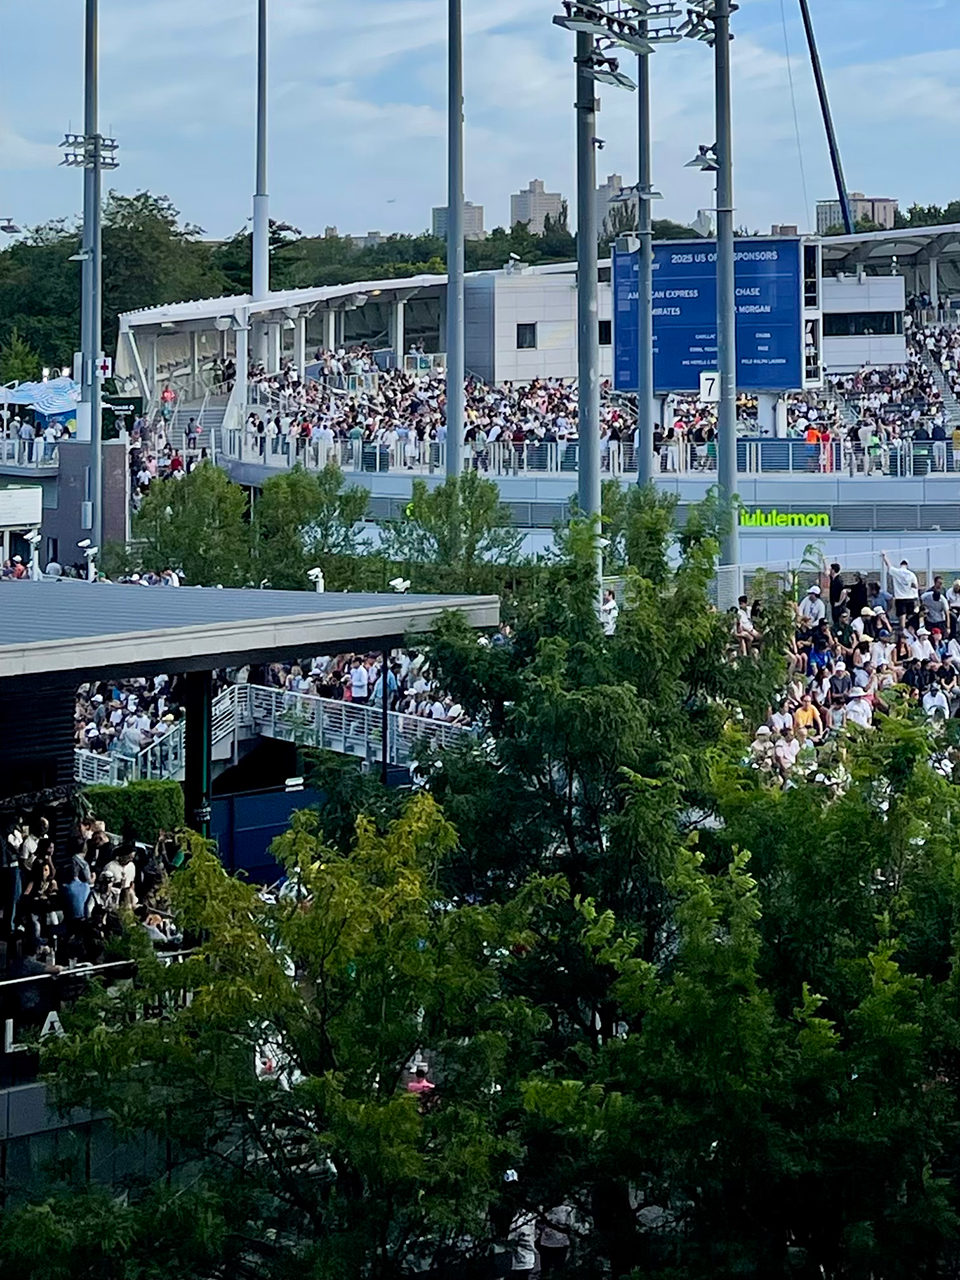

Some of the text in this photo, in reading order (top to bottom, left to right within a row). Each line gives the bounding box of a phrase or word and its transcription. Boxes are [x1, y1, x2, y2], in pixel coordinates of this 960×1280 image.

[671, 254, 693, 263] 2025
[695, 253, 706, 262] US
[733, 251, 778, 260] SPONSORS
[666, 289, 698, 298] EXPRESS
[735, 287, 760, 295] CHASE
[739, 305, 771, 313] MORGAN
[705, 377, 716, 397] 7
